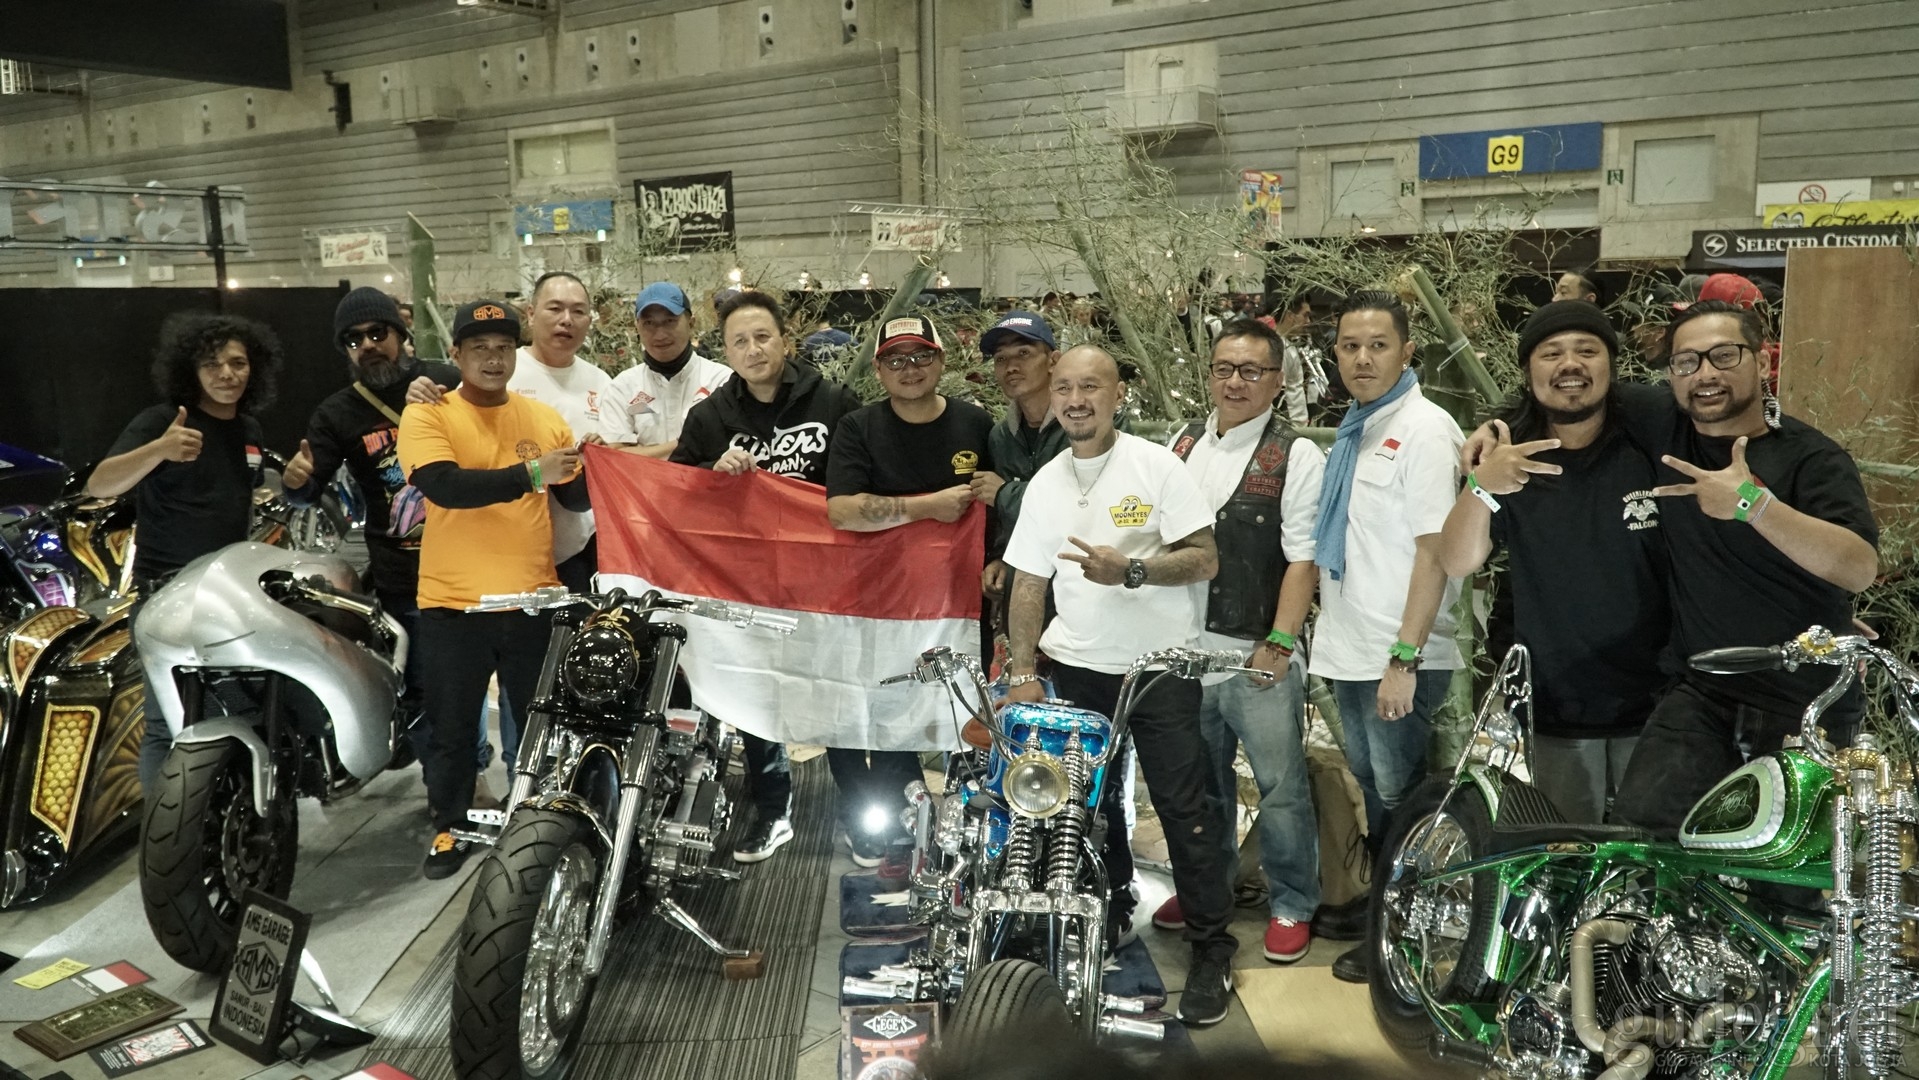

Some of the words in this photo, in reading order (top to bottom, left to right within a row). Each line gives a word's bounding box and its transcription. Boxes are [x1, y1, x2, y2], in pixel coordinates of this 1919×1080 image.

[1492, 144, 1519, 166] G9
[1736, 235, 1818, 253] SELECTED
[1822, 232, 1899, 248] CUSTOM
[1010, 317, 1033, 326] ENGINE
[362, 430, 389, 456] HOT
[1114, 511, 1148, 519] MOONEYES
[244, 912, 262, 934] AMS
[260, 915, 292, 946] GARAGE
[241, 948, 275, 989] AMS
[229, 990, 251, 1010] SANUR
[252, 1001, 268, 1018] BALI
[224, 1003, 266, 1037] INDONESIA
[872, 1014, 908, 1034] GEGE'S
